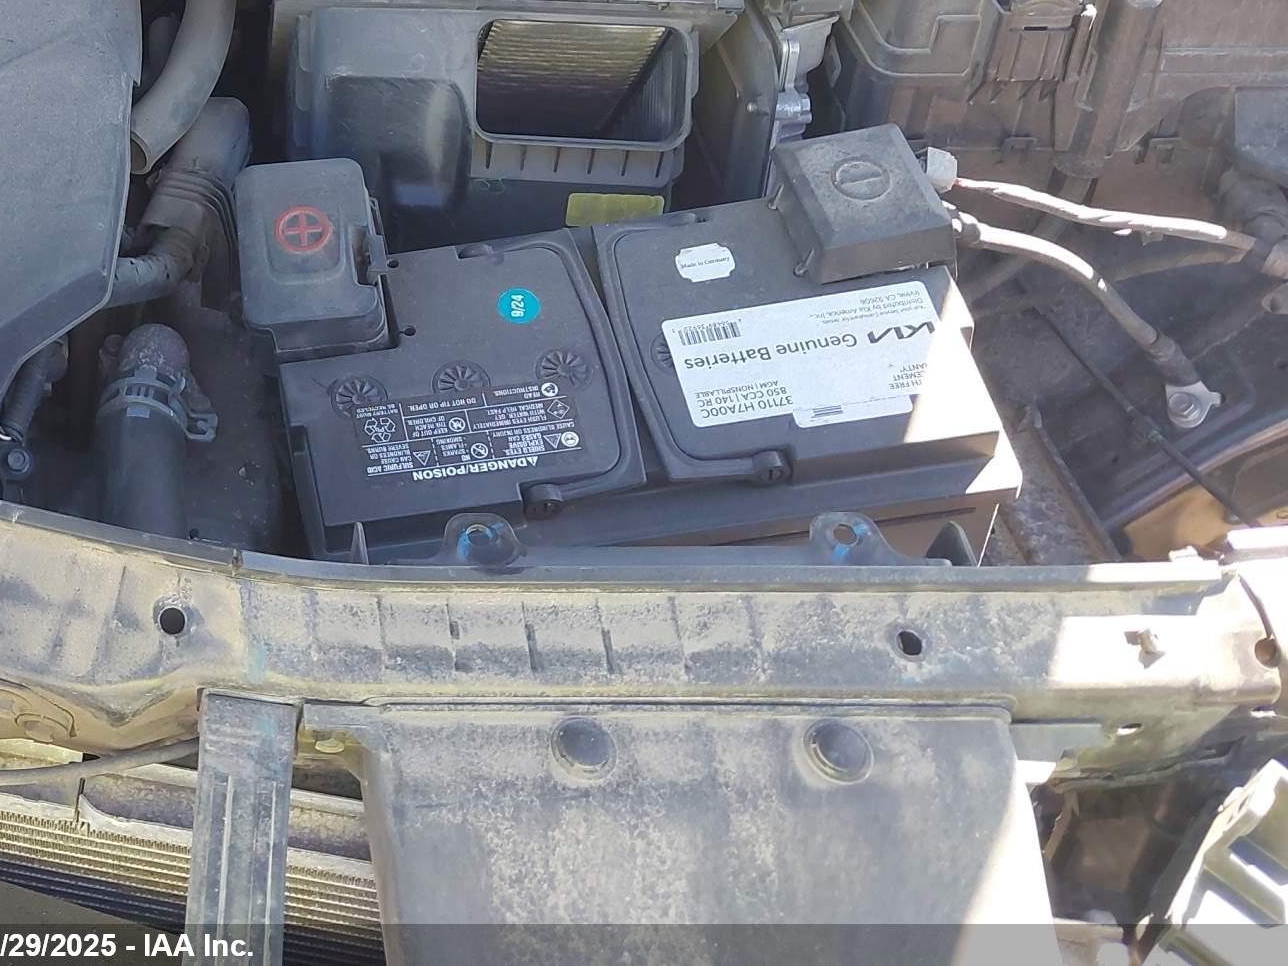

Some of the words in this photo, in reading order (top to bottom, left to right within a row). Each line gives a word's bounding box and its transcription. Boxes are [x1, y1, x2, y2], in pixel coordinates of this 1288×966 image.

[511, 295, 526, 317] 9/24
[866, 320, 935, 343] KIA
[775, 332, 857, 358] Genuine
[683, 346, 771, 372] Batteries
[759, 380, 778, 388] AGM
[888, 380, 909, 389] FREE
[694, 384, 753, 398] NONSPILLABLE
[741, 390, 764, 400] CCA
[766, 386, 786, 396] 850
[697, 398, 712, 407] RC
[714, 394, 733, 404] 140
[757, 395, 792, 409] 37110
[473, 419, 511, 429] IMMEDIATELY
[523, 424, 555, 433] BLINDNESS
[556, 421, 575, 429] CAUSE
[436, 436, 462, 444] SMOKING
[522, 432, 541, 440] GASES
[388, 443, 409, 451] SEVERE
[441, 442, 464, 450] FLAMES
[509, 439, 543, 448] EXPLOSIVE
[379, 449, 411, 458] BLINDNESS
[443, 448, 465, 456] SPARKS
[523, 445, 545, 453] SHIELD
[367, 465, 382, 473] ACID
[383, 461, 413, 471] SULFURIC
[413, 457, 527, 480] DANGER/POISON
